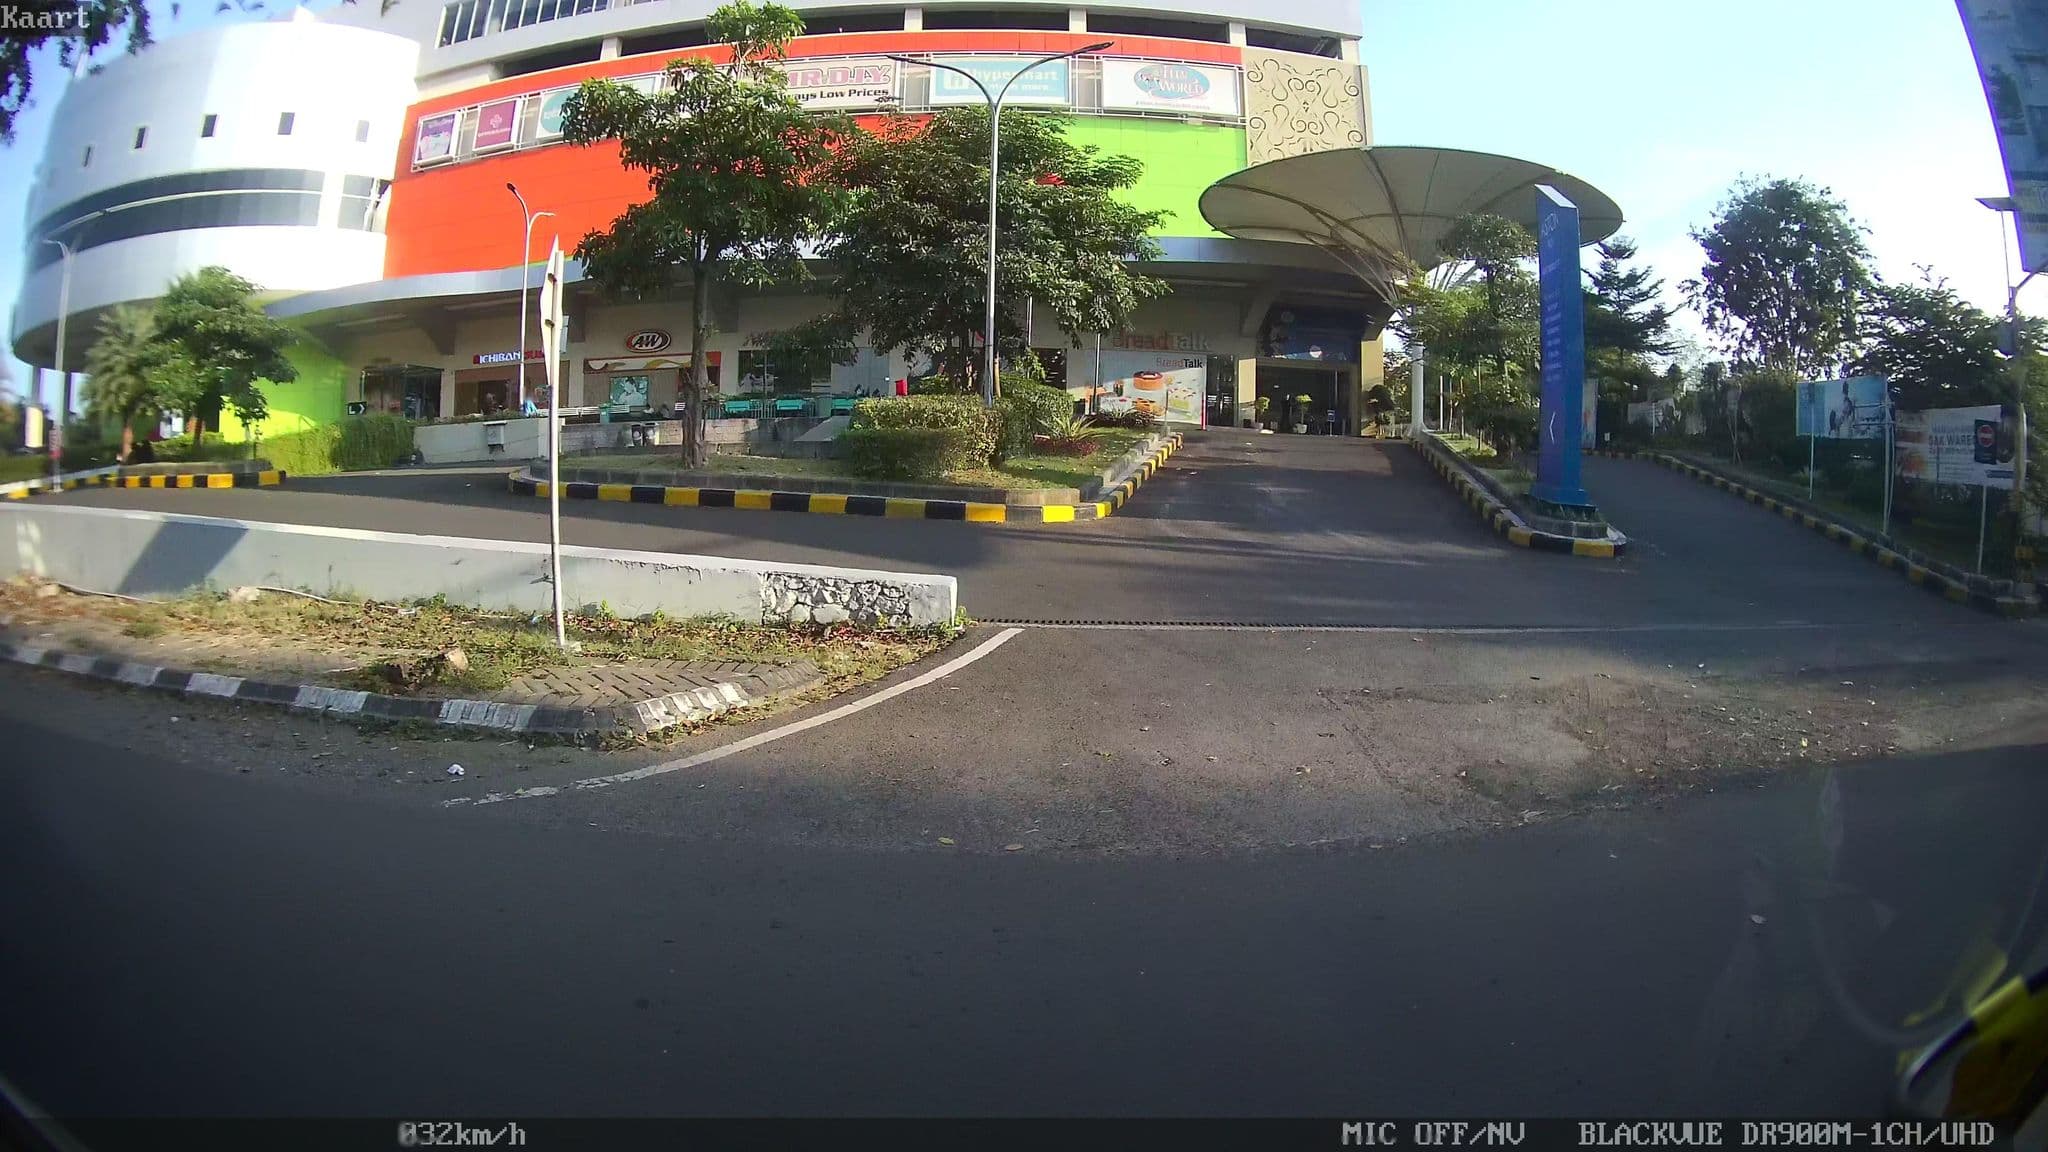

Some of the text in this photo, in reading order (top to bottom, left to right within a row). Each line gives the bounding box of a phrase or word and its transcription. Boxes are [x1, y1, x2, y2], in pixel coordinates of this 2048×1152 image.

[820, 90, 845, 99] Low
[848, 88, 889, 98] Prices
[480, 351, 521, 364] ICHIBAN
